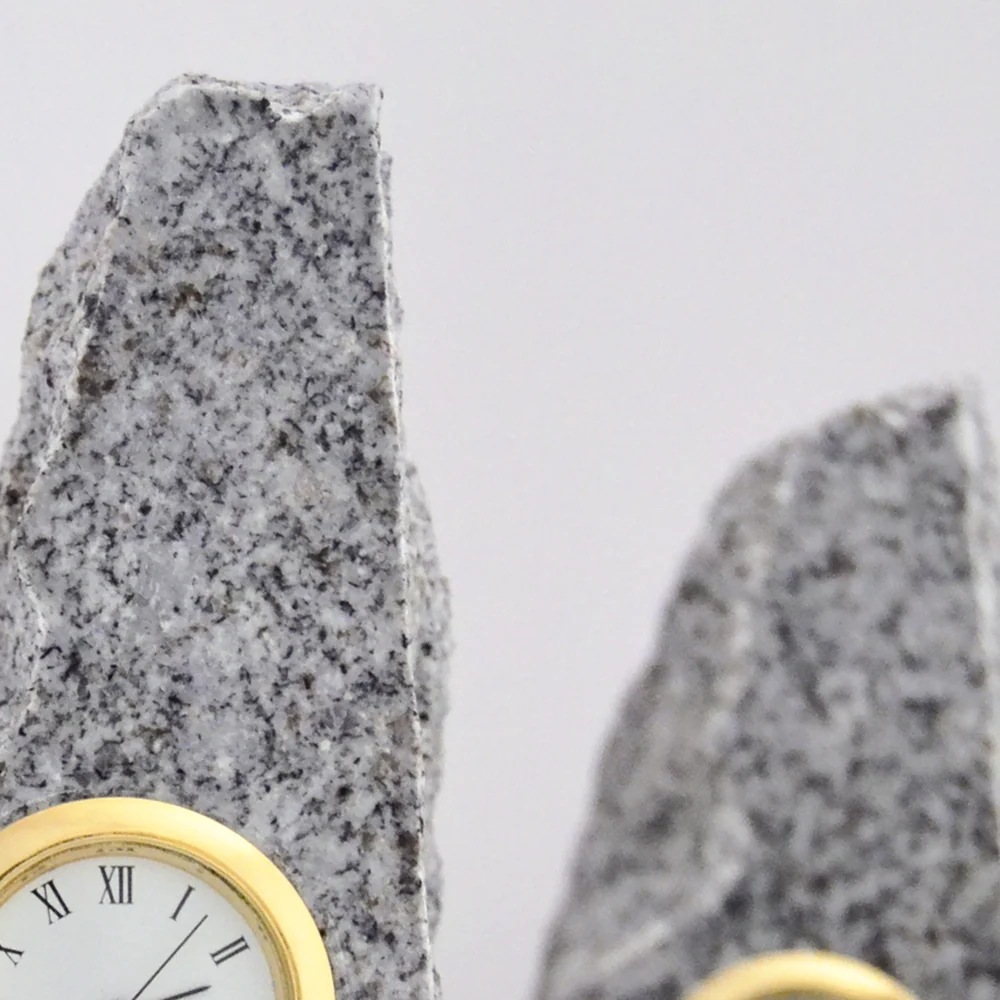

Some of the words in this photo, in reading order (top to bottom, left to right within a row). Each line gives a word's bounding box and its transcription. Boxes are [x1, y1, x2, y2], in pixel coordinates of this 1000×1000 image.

[30, 879, 72, 925] XI
[99, 866, 134, 904] XII
[211, 936, 249, 965] II
